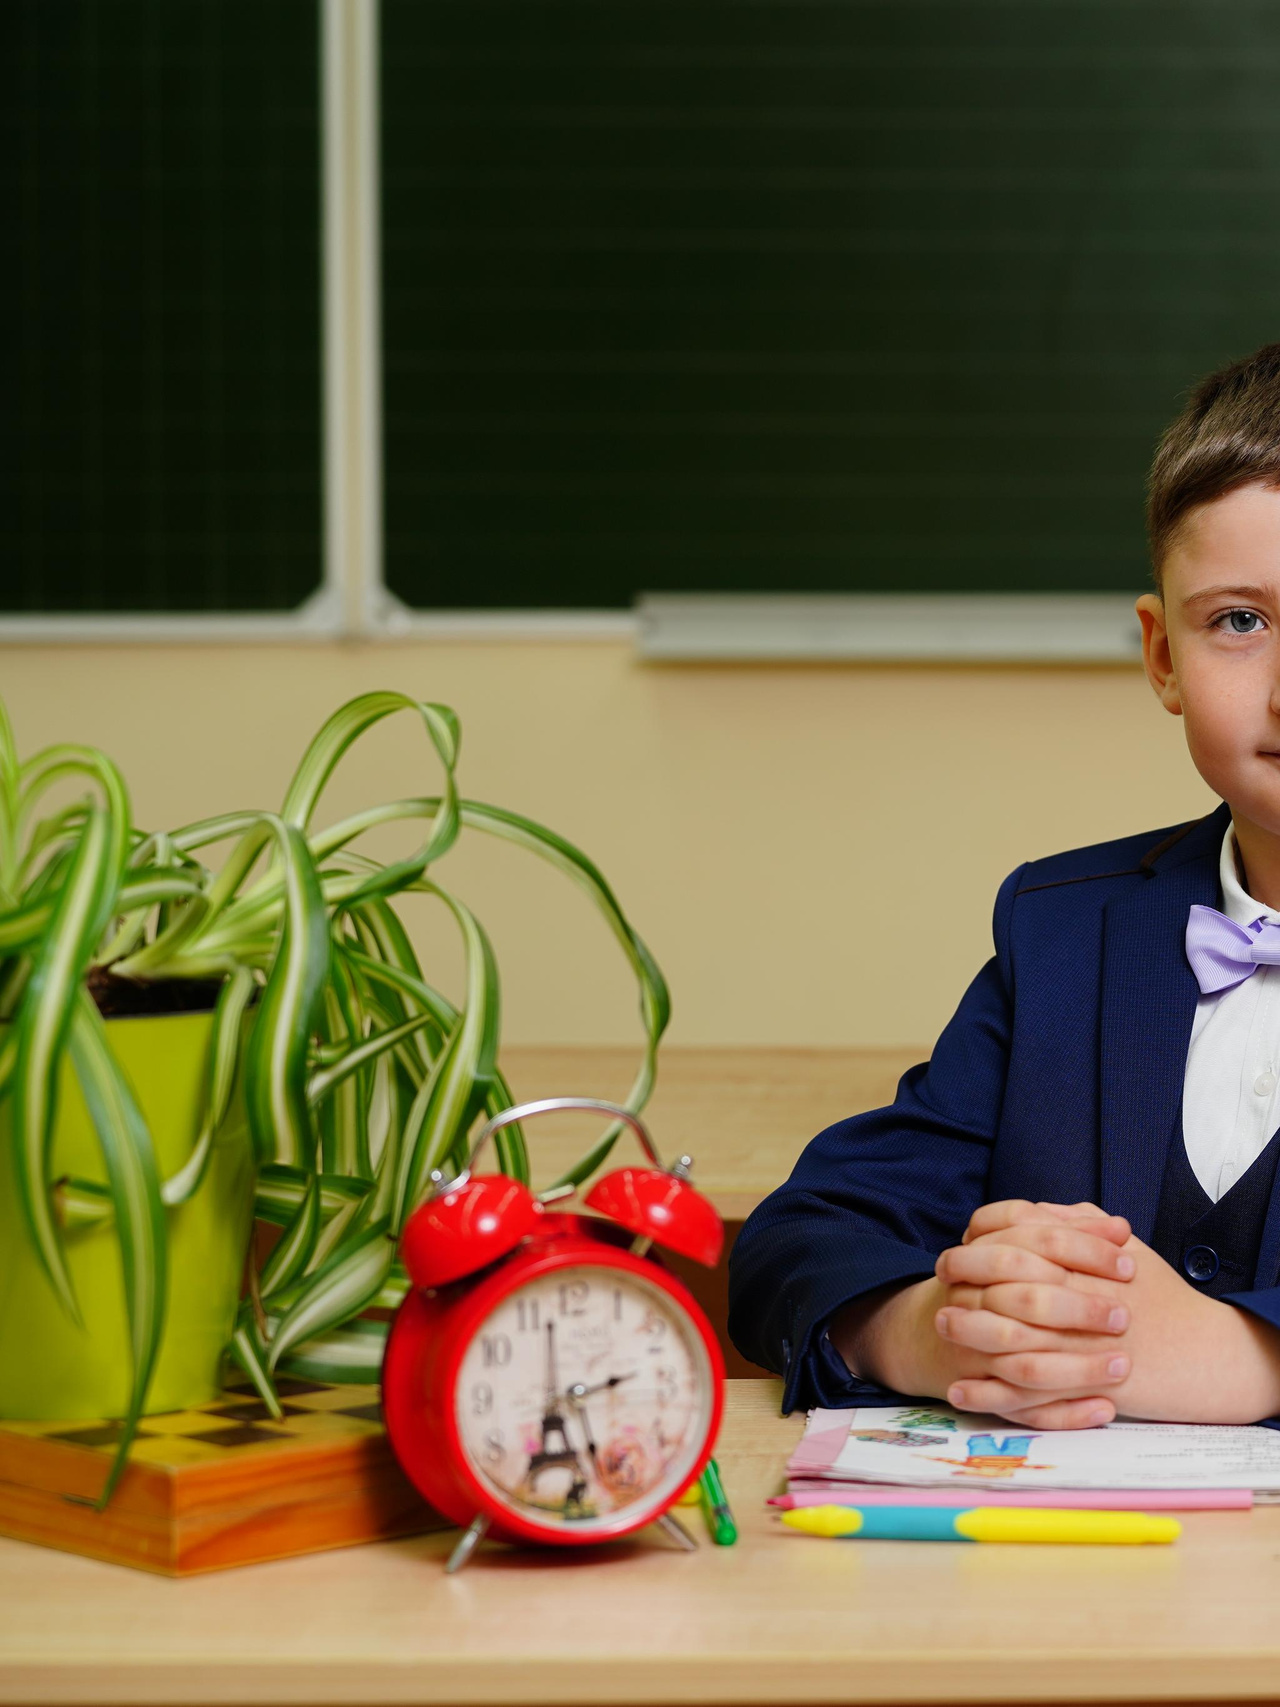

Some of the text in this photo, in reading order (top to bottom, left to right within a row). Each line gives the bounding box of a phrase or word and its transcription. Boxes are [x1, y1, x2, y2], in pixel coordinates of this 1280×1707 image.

[516, 1298, 540, 1332] 11
[558, 1279, 590, 1317] 12
[613, 1287, 622, 1321] 1
[481, 1333, 512, 1368] 10
[471, 1380, 493, 1417] 9
[483, 1427, 507, 1464] 8
